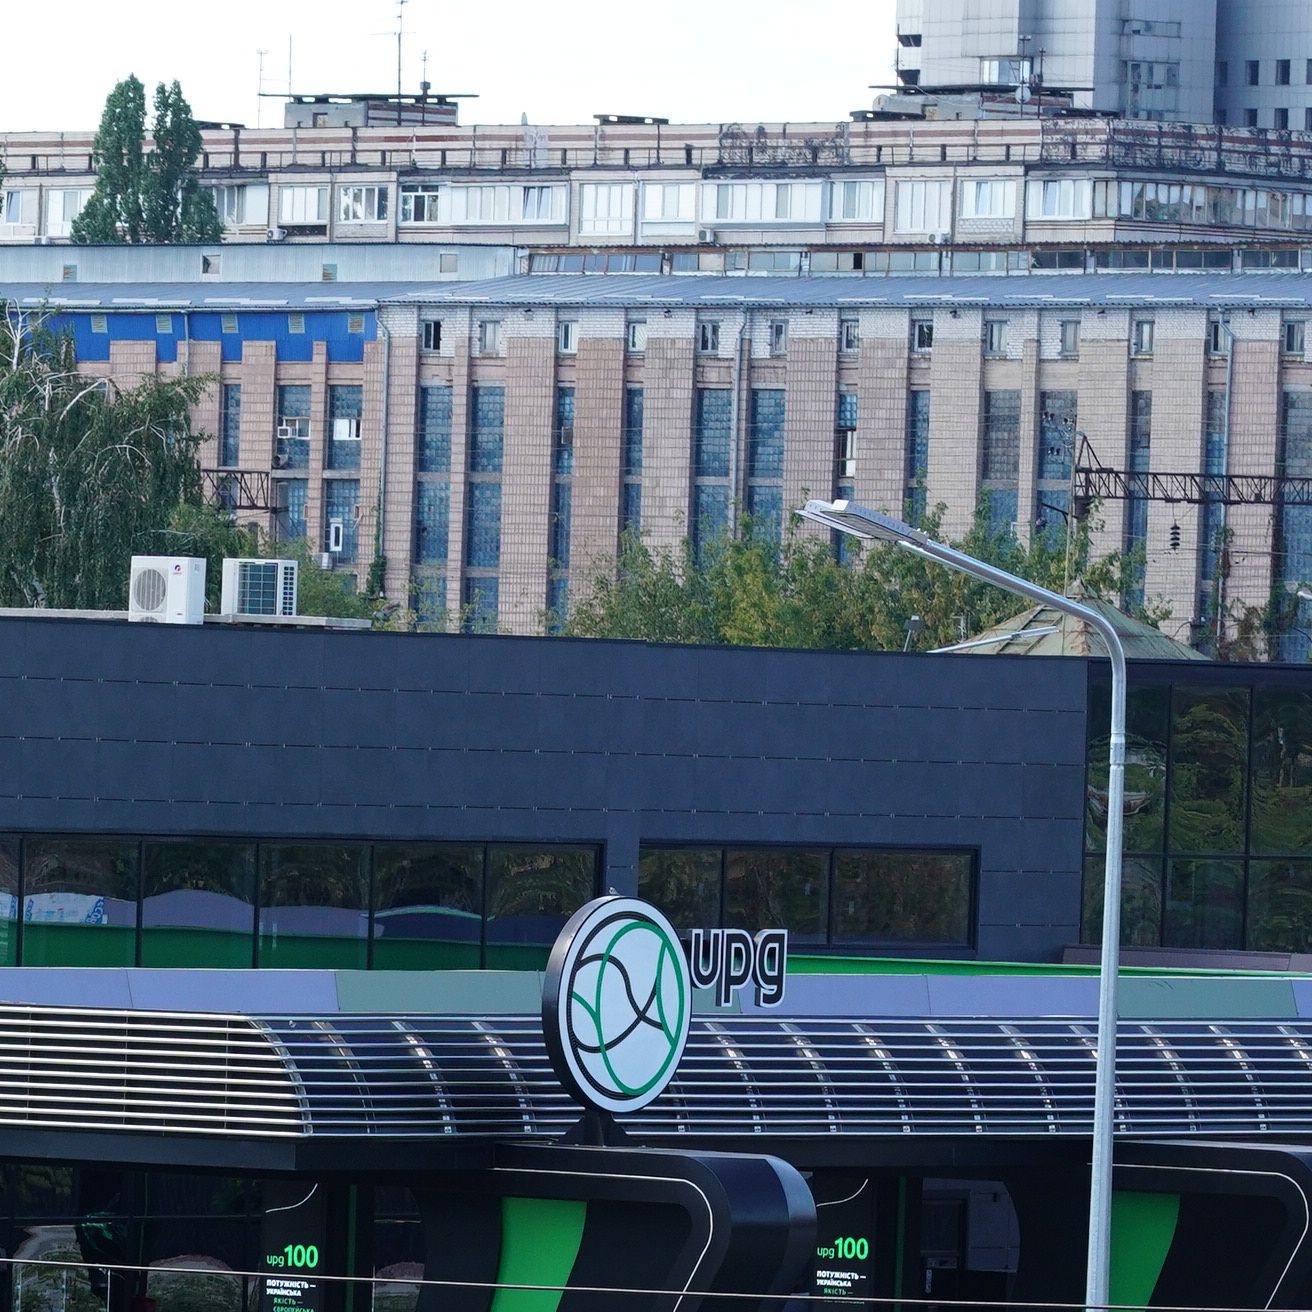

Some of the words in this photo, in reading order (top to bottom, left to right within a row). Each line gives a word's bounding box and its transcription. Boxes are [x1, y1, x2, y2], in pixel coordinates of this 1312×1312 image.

[691, 929, 788, 1008] upg
[284, 1244, 319, 1268] 100
[835, 1237, 869, 1260] 100
